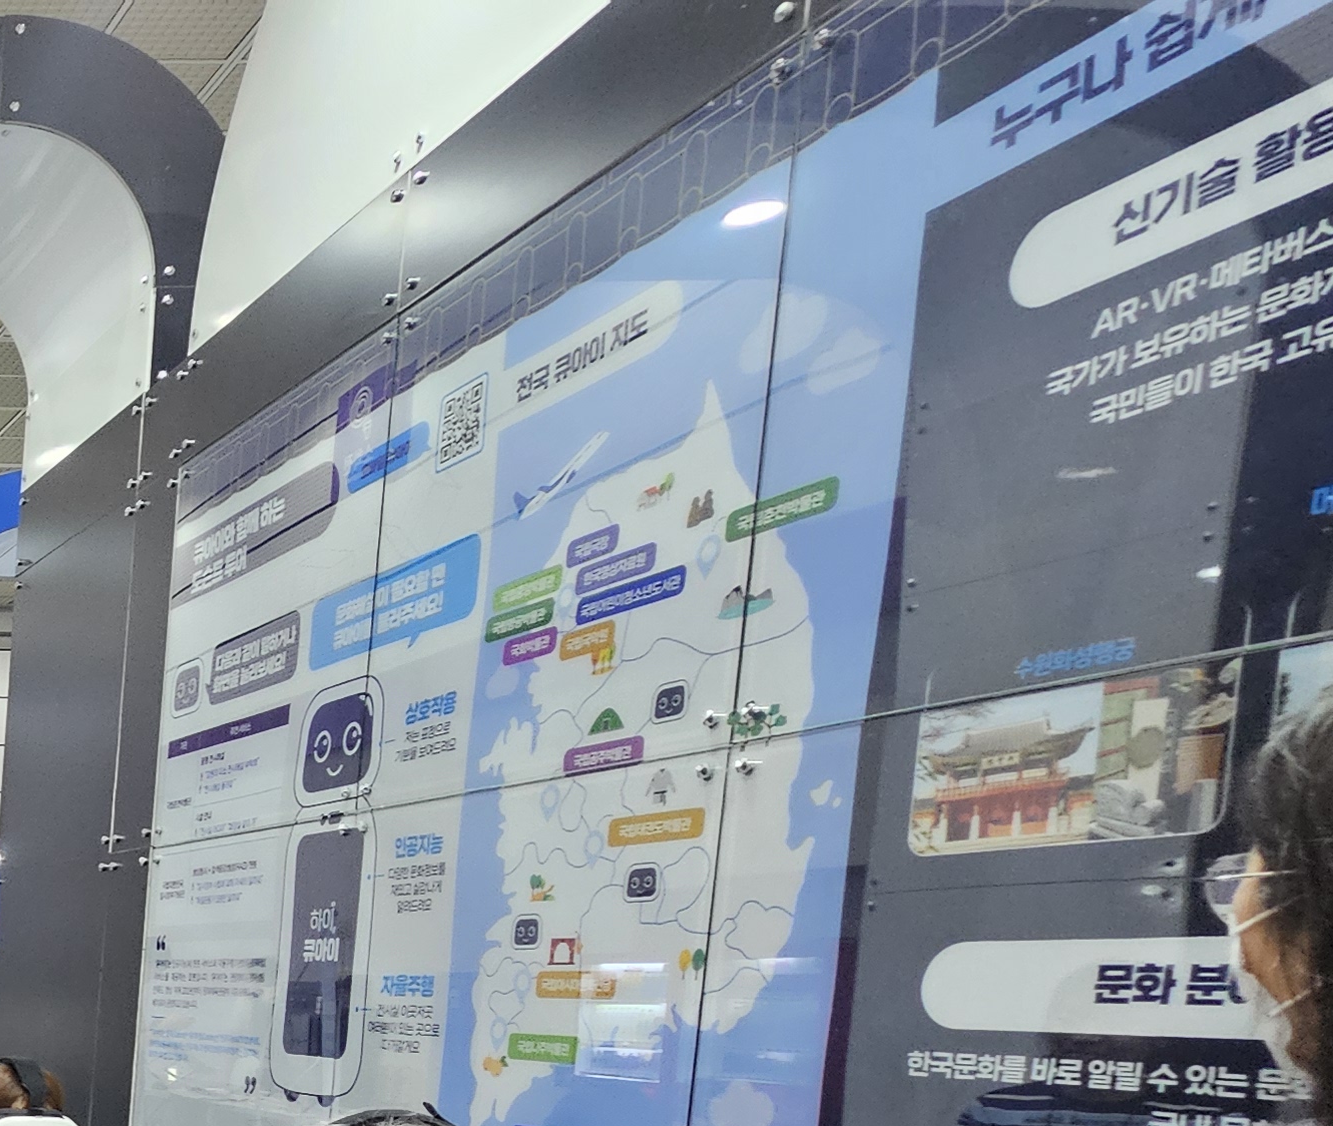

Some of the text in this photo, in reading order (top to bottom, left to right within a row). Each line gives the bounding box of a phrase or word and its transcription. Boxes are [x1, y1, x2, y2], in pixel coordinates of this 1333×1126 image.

[991, 35, 1132, 149] 누구나
[1113, 107, 1333, 247] 신기술 활용
[516, 308, 650, 403] 전국 큐아이 지도
[1045, 347, 1128, 395] 국가가
[1130, 303, 1253, 369] 보유하는
[1089, 363, 1203, 425] 국민들이
[1209, 337, 1274, 388] 한국
[260, 496, 286, 528] 하는
[405, 690, 457, 725] 상호작용
[395, 832, 444, 859] 인공지능
[303, 936, 341, 963] 큐아이
[380, 974, 435, 998] 자율주행
[1093, 963, 1177, 1006] 문화
[907, 1049, 1028, 1085] 한국문화를
[1031, 1058, 1084, 1087] 바로
[1088, 1060, 1144, 1092] 알릴
[1146, 1064, 1179, 1094] 수
[1184, 1064, 1250, 1099] 있는
